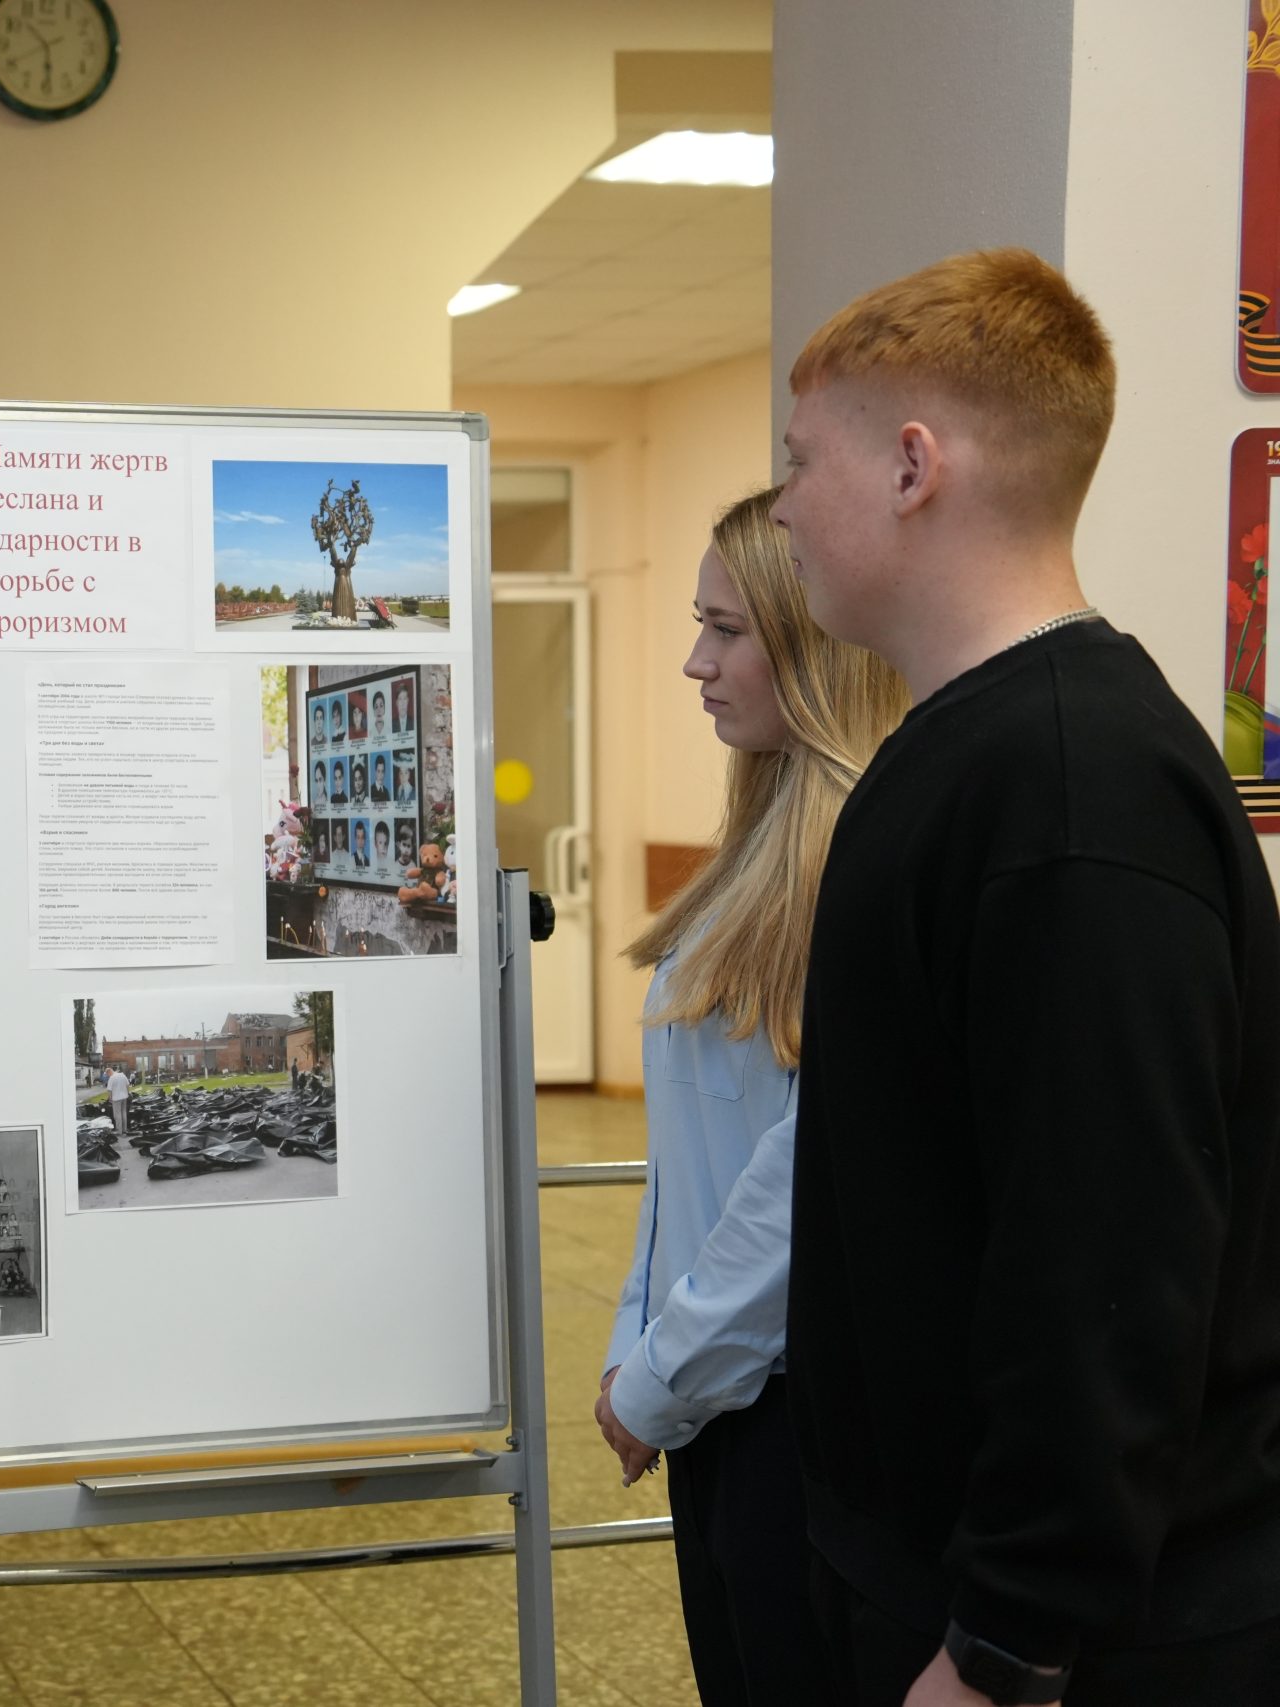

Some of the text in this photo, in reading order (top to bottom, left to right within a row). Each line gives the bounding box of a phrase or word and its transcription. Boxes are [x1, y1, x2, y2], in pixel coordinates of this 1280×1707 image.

[90, 454, 169, 478] жертв
[89, 494, 104, 511] и
[128, 536, 142, 552] в
[83, 576, 96, 593] с
